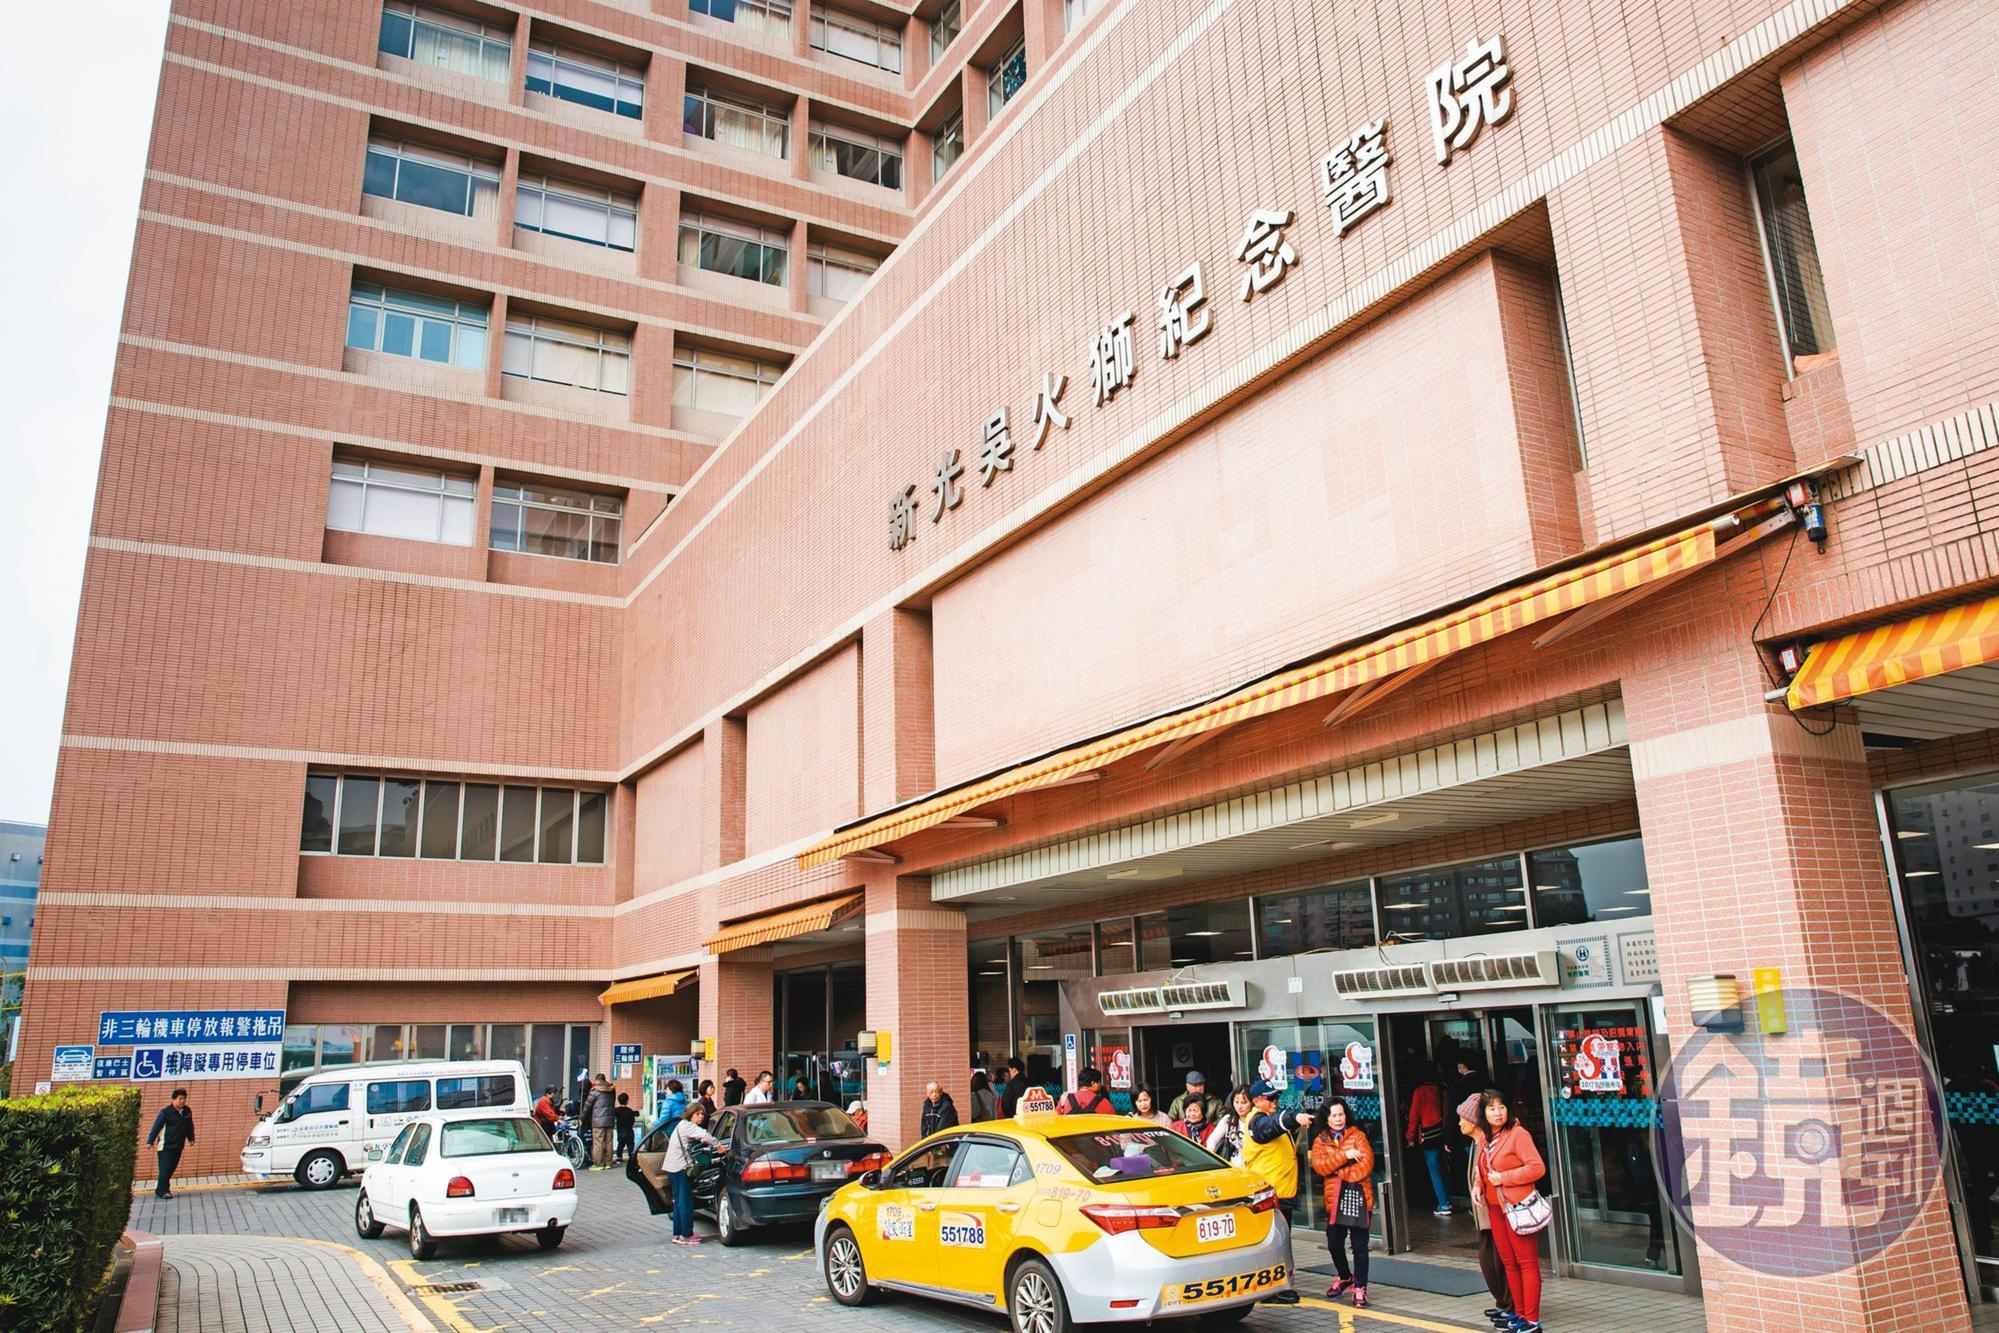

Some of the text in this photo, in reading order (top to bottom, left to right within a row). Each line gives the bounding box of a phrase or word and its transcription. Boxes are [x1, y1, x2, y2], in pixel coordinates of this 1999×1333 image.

[888, 33, 1517, 551] 新光吳火獅紀念醫院
[102, 1016, 282, 1040] 非三輪機車停放報警拖吊
[165, 1051, 276, 1075] 無障礙專用停車位
[1030, 1101, 1053, 1112] 551788
[1036, 1162, 1061, 1174] 1709
[1050, 1186, 1092, 1202] 819-7D
[941, 1226, 984, 1244] 551788
[1199, 1218, 1235, 1239] 819-7D
[1182, 1265, 1286, 1300] 551788
